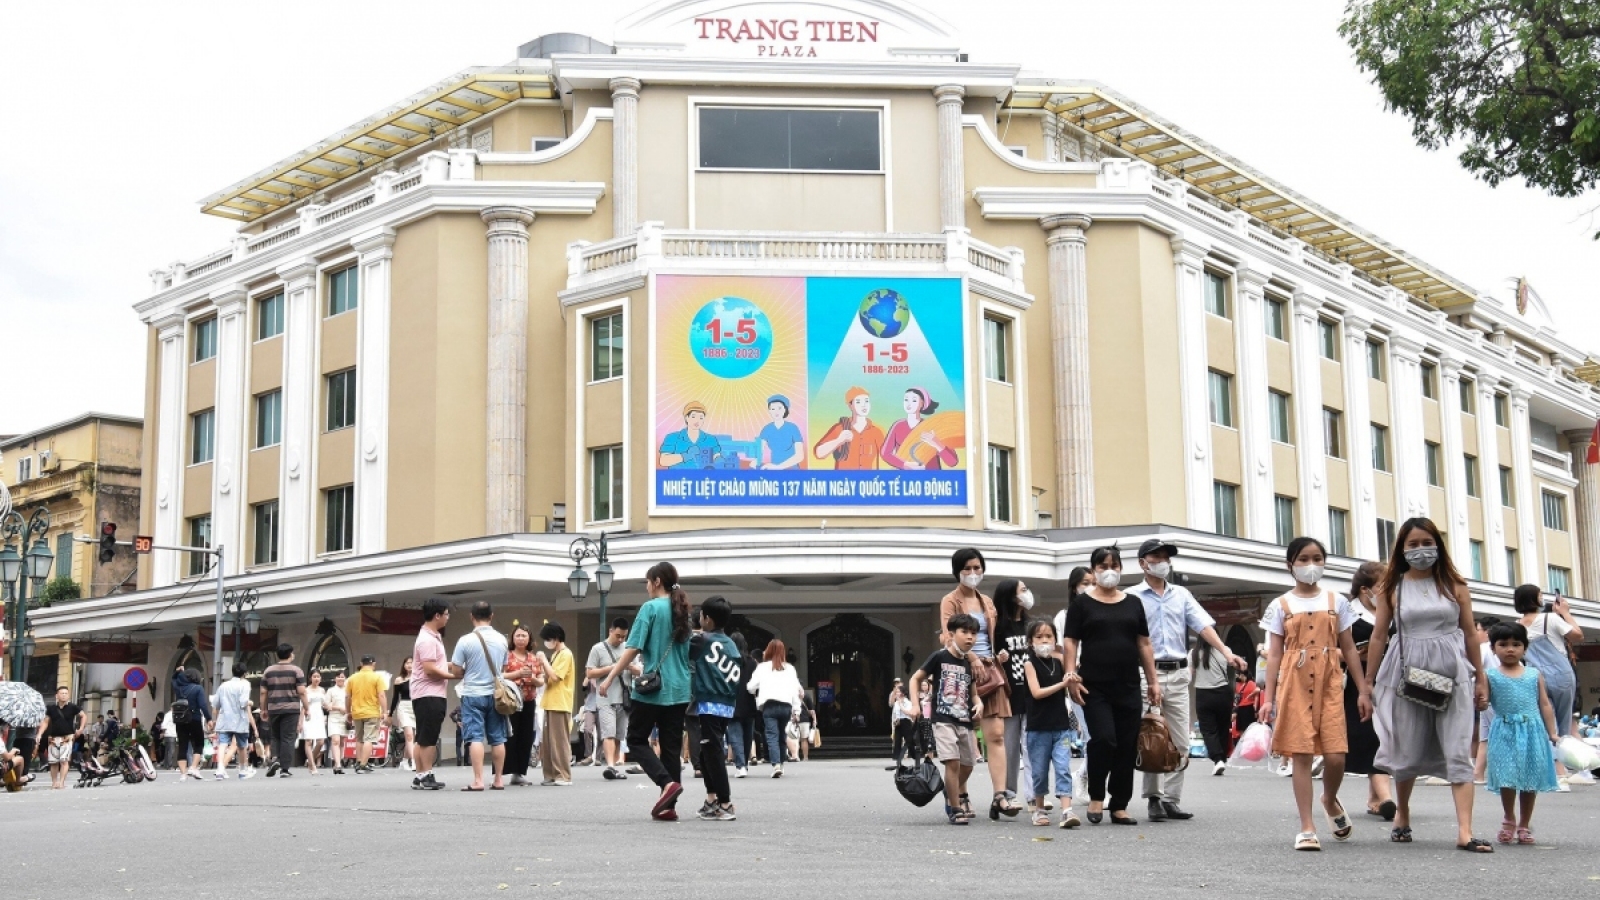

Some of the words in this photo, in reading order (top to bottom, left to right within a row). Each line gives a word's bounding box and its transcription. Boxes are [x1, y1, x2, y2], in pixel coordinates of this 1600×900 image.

[694, 18, 799, 43] TRANG
[805, 20, 880, 43] TIEN
[757, 45, 818, 58] PLAZA
[705, 317, 758, 345] 1-5
[861, 342, 909, 363] 1-5
[861, 365, 910, 375] 1886-2023
[663, 477, 692, 500] NHIỆT
[695, 477, 717, 500] LIỆT
[718, 477, 746, 497] CHÀO
[748, 476, 780, 497] MỪNG
[782, 480, 801, 497] 137
[803, 477, 827, 497] NĂM
[829, 477, 857, 497] NGÀY
[859, 475, 887, 499] QUỐC
[888, 475, 901, 497] TẾ
[903, 480, 922, 497] LAO
[924, 477, 953, 500] ĐỘNG
[135, 538, 150, 551] 30
